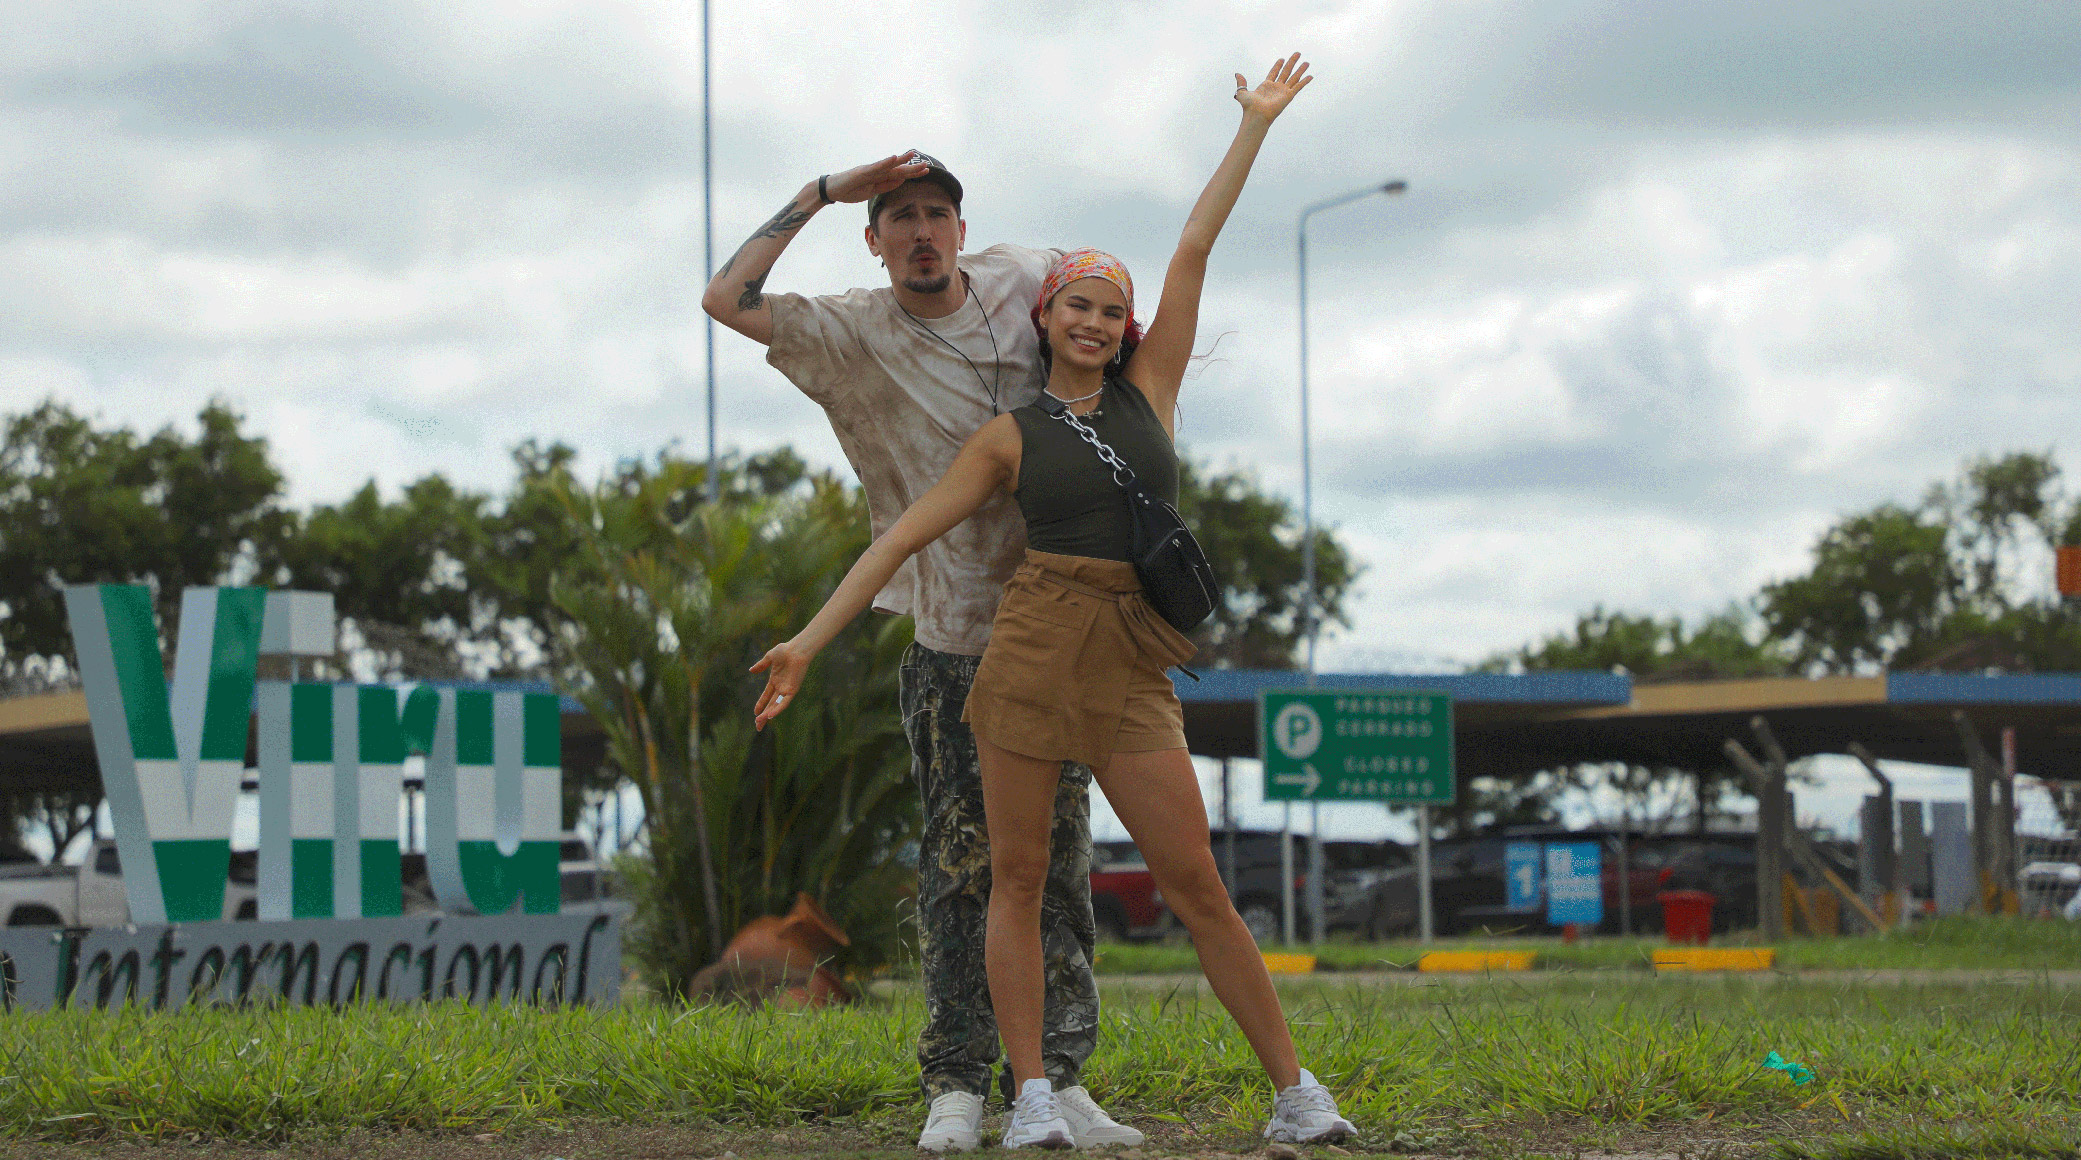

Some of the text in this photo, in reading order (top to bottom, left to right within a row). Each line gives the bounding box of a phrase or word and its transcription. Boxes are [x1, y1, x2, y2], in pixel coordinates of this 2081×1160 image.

[1335, 696, 1432, 715] PARQUEO
[1288, 714, 1310, 749] P
[1335, 718, 1433, 738] CERRADO
[64, 584, 562, 922] Viru
[1343, 755, 1430, 774] CLOSED
[1336, 778, 1435, 797] PARKING
[54, 914, 610, 1012] Internacional
